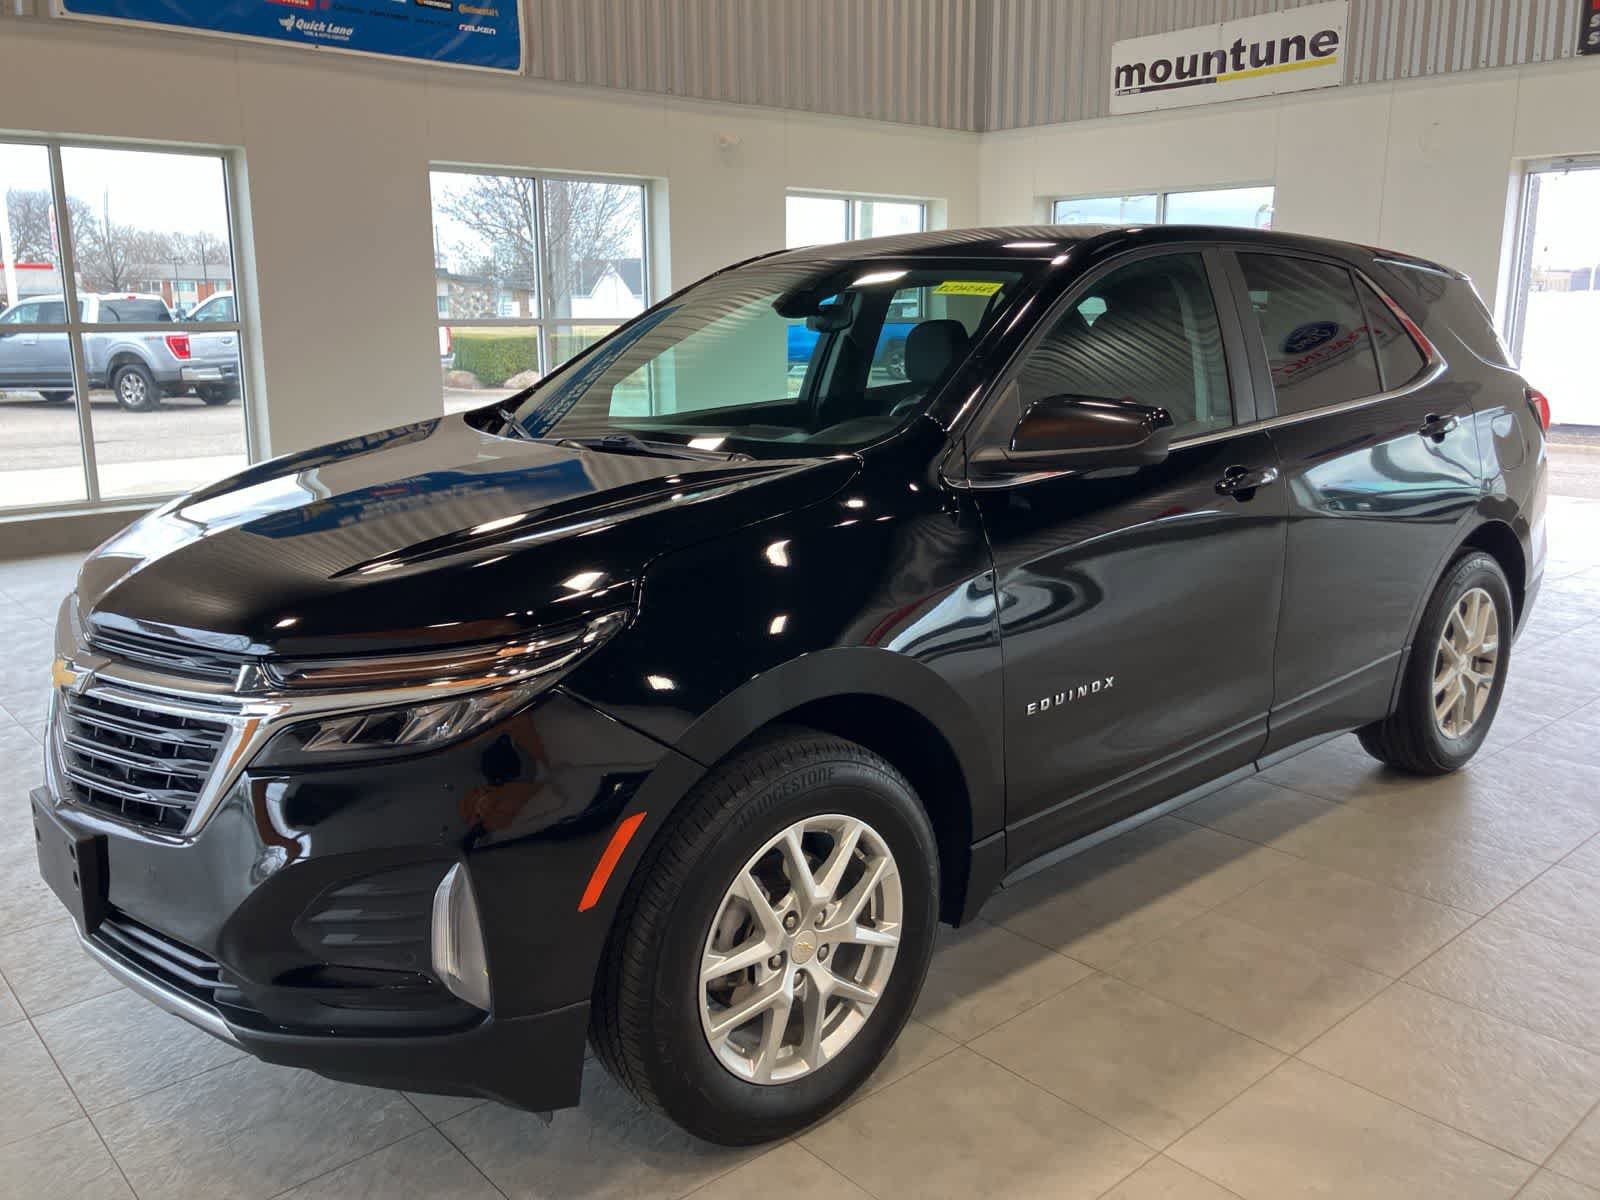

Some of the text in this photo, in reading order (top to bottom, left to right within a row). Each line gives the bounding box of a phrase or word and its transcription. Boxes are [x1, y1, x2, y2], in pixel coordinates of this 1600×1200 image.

[295, 18, 326, 32] Quick
[326, 23, 353, 36] Lane
[458, 23, 496, 35] FALKEN
[1114, 29, 1339, 89] mountune
[1027, 676, 1115, 716] EQUINOX
